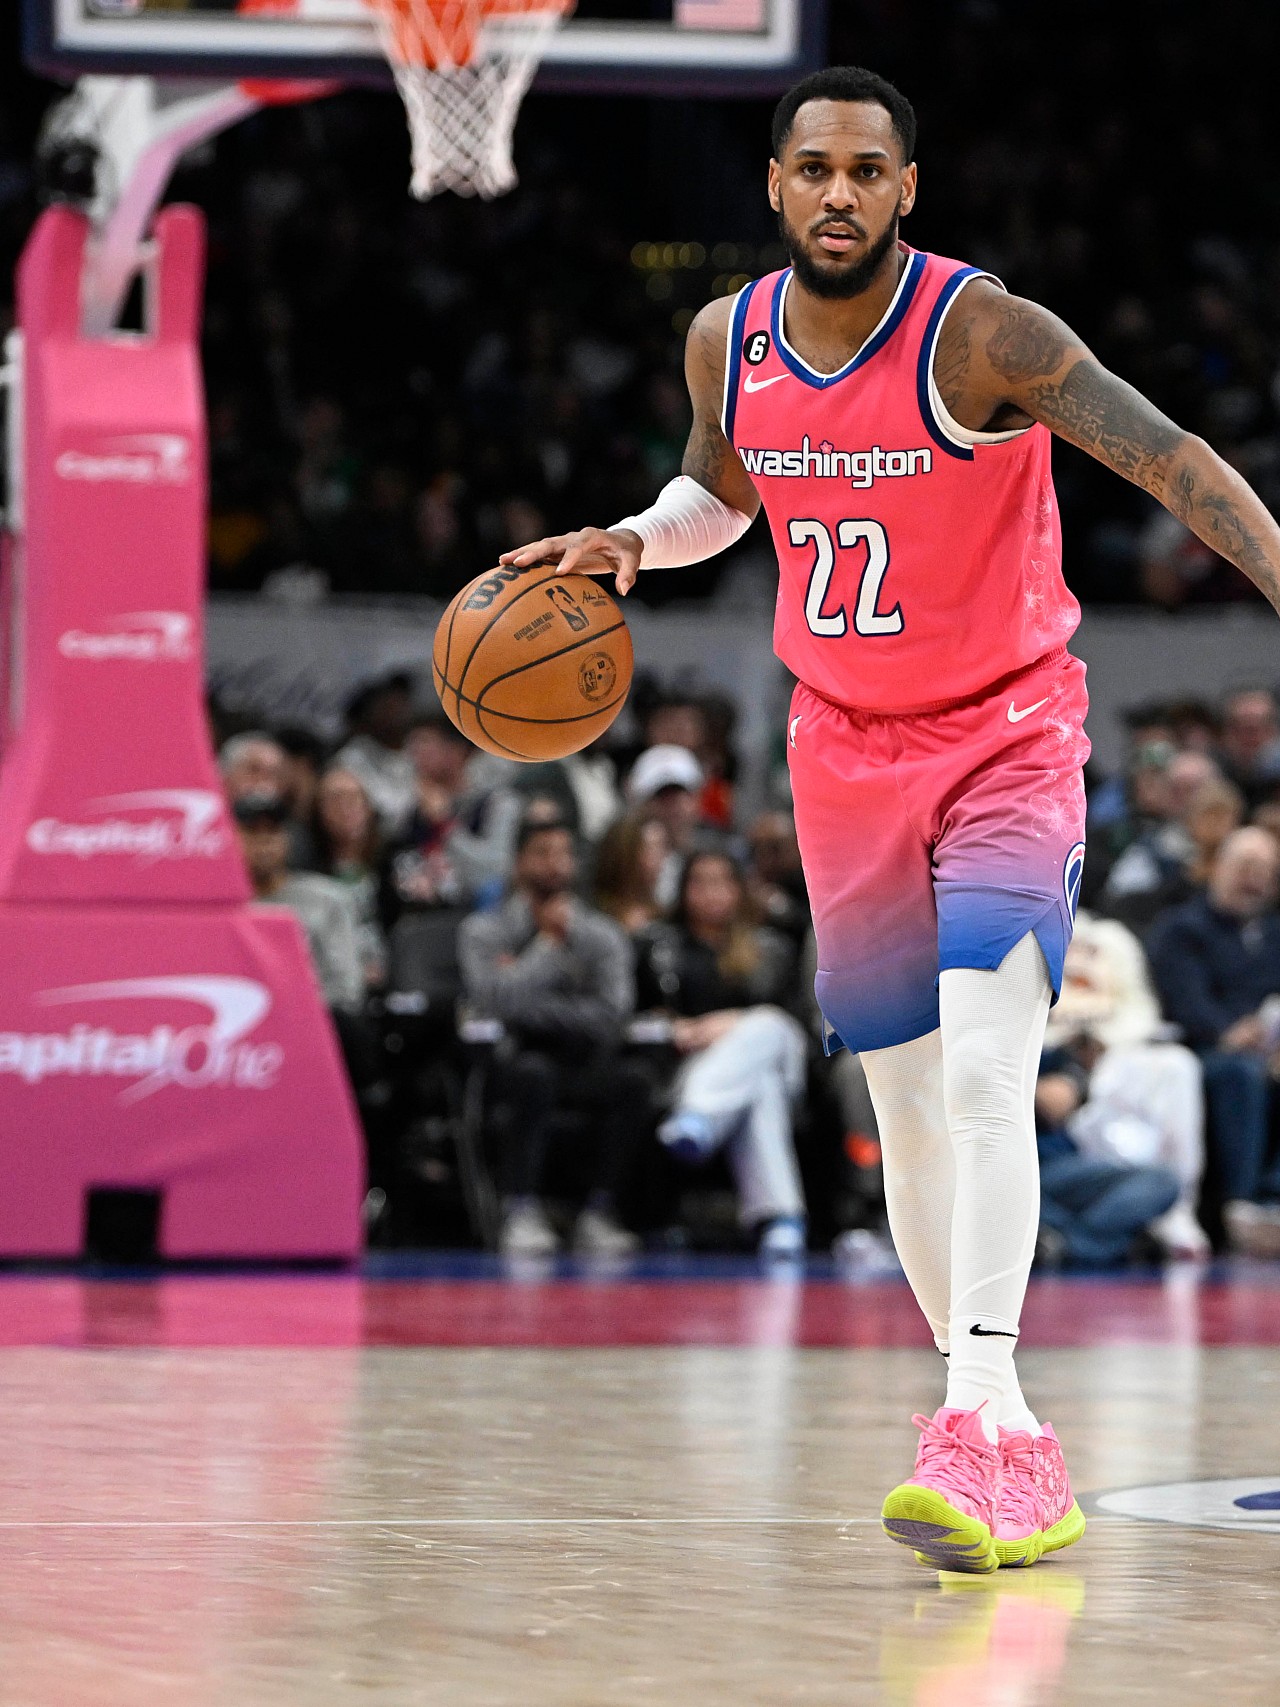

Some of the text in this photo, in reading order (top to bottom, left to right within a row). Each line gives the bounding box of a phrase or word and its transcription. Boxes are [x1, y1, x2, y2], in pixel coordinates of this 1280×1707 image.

[748, 335, 767, 361] 6
[738, 434, 932, 488] washington
[787, 518, 905, 638] 22
[0, 1023, 173, 1085] apital
